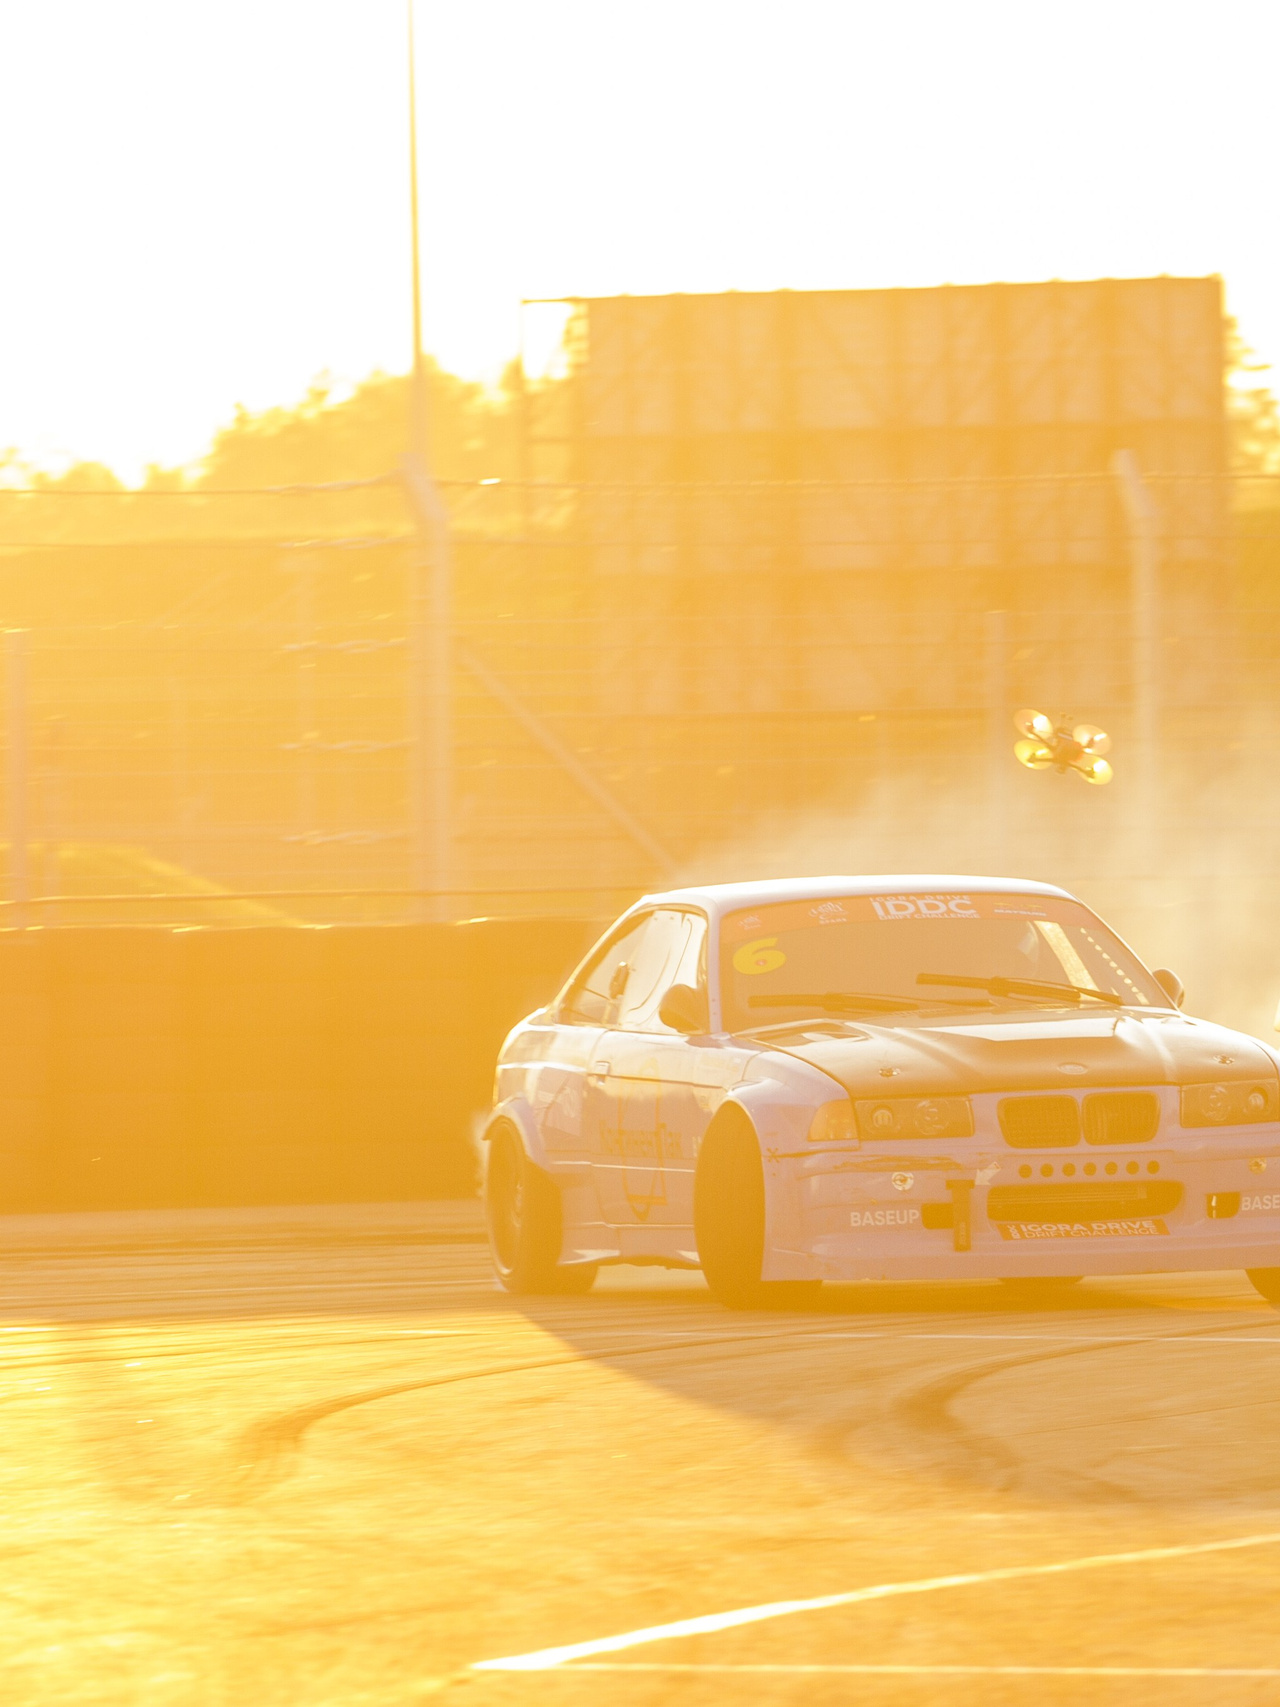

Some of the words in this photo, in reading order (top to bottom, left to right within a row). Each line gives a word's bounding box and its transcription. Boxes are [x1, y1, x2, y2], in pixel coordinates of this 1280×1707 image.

[871, 899, 978, 915] IDDC
[732, 937, 787, 975] 6
[850, 1209, 920, 1227] BASEUP
[1019, 1223, 1088, 1233] IGORA
[1091, 1220, 1155, 1230] DRIVE
[1024, 1230, 1068, 1239] DRIFT
[1070, 1228, 1158, 1237] CHALLENGE
